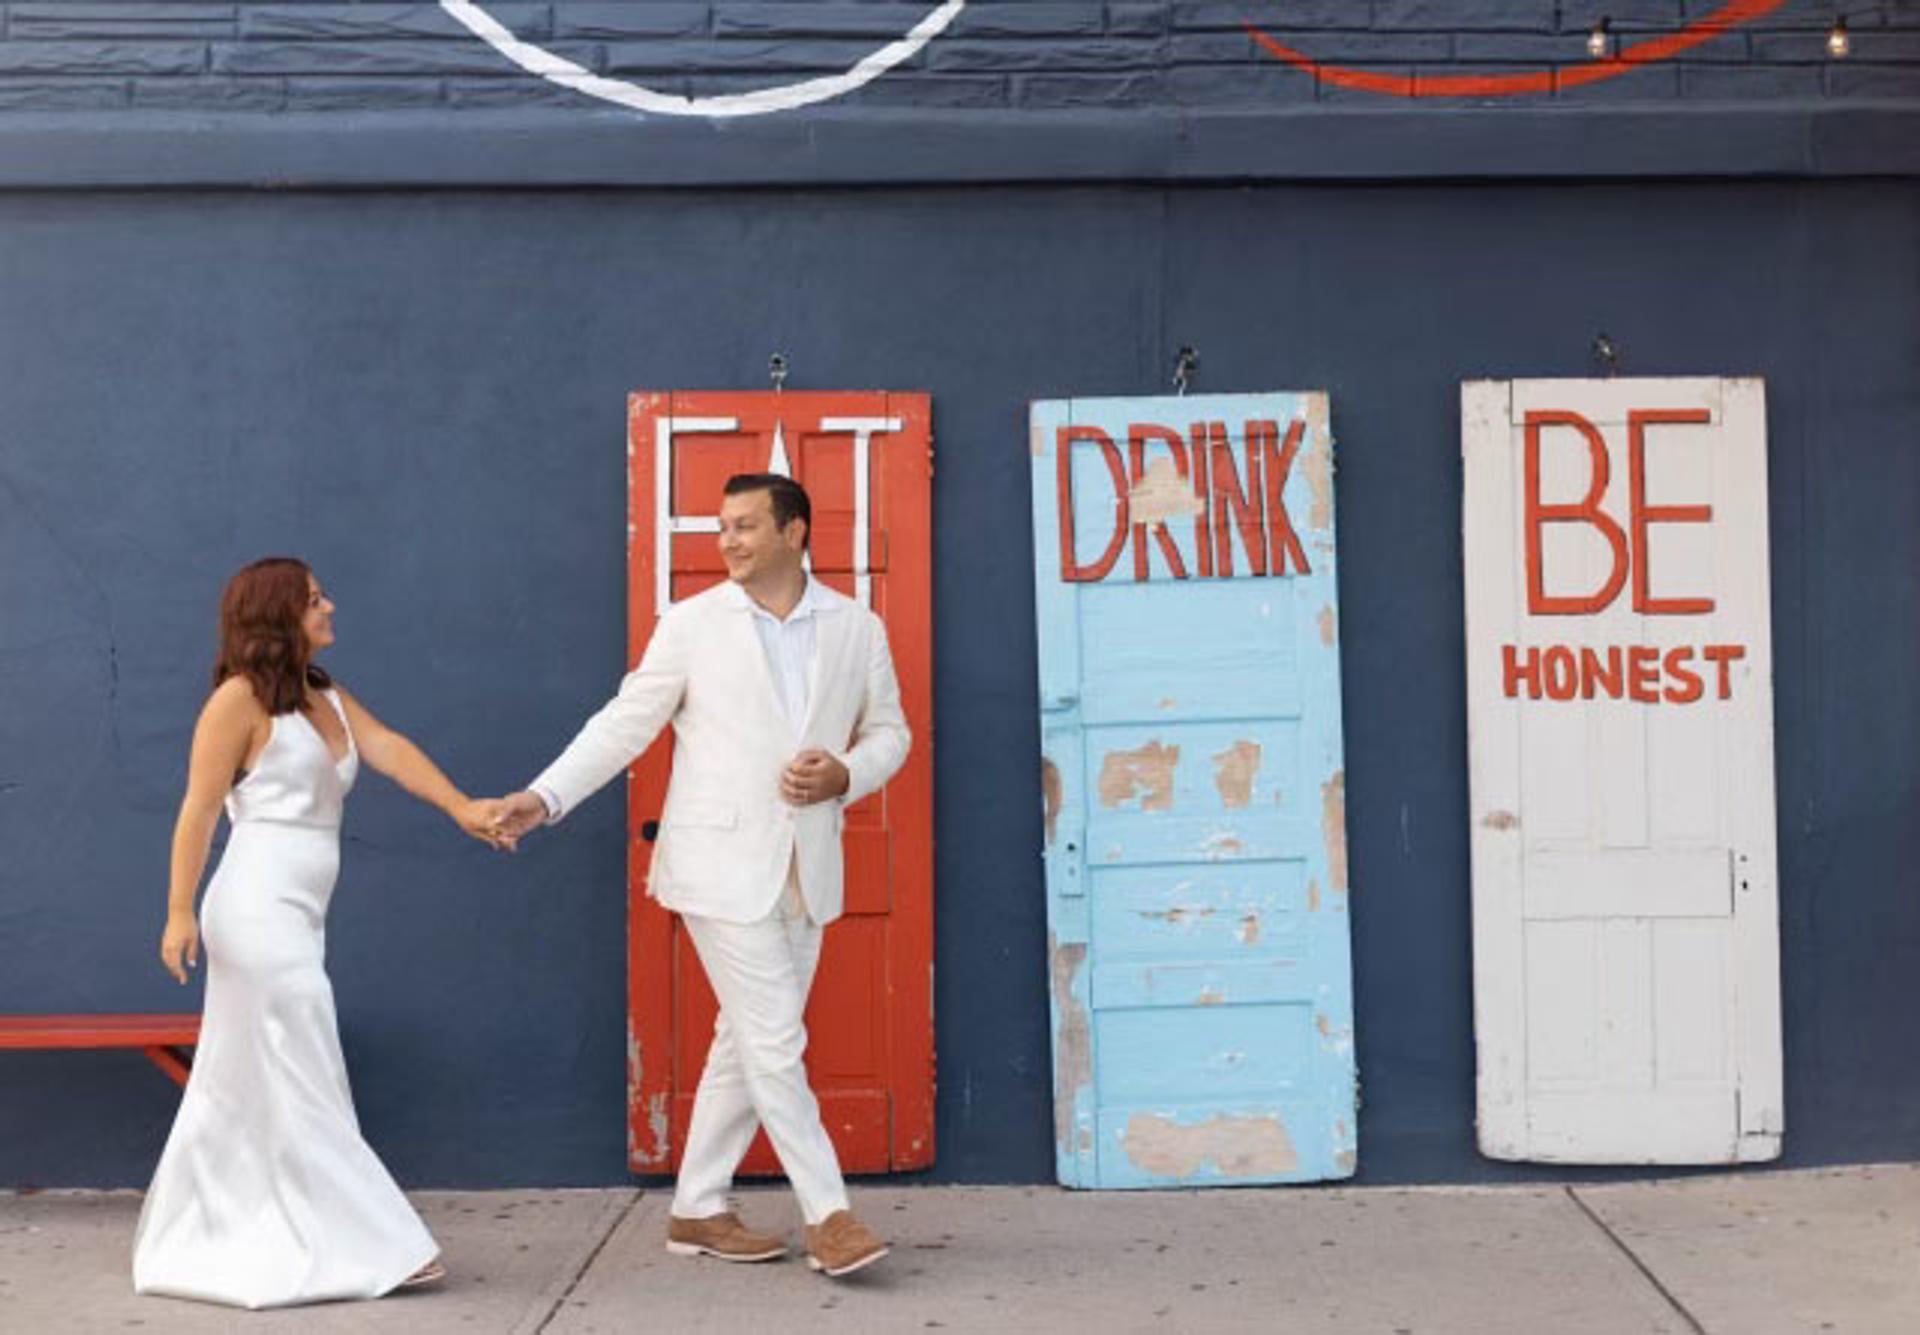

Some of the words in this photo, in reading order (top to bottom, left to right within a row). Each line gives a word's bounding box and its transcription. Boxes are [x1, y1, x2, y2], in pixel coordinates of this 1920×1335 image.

[1056, 419, 1311, 583] DRINK
[1524, 408, 1715, 616] BE
[1501, 645, 1746, 704] HONEST
